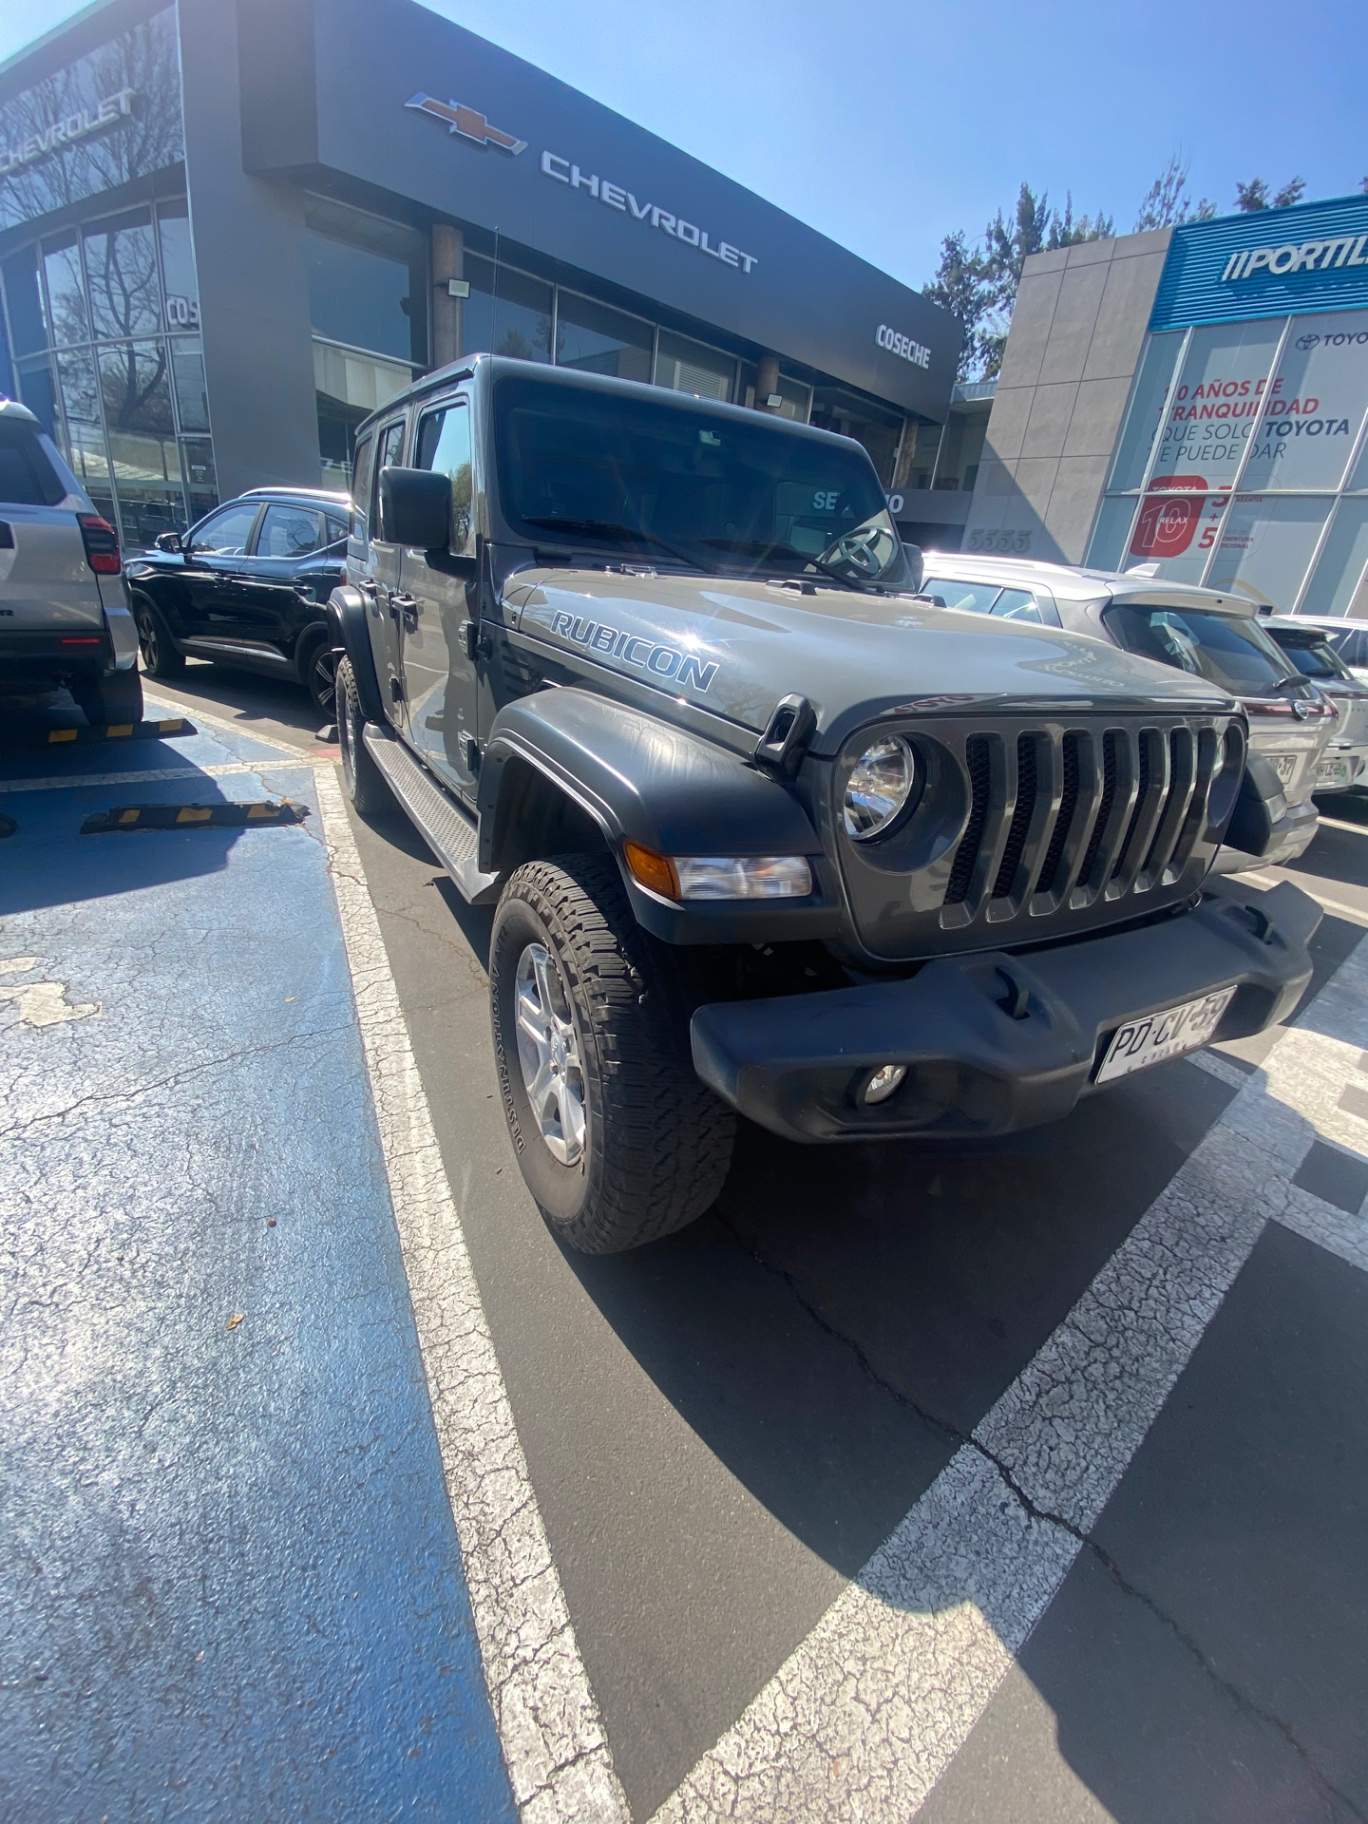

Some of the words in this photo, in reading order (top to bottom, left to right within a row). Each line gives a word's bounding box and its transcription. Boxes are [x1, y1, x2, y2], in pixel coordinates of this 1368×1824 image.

[541, 150, 758, 273] CHEVROLET
[876, 324, 931, 369] COSECHE
[1192, 379, 1250, 399] AÑOS
[1265, 419, 1349, 438] TOYOTA
[1176, 444, 1239, 461] PUEDE
[1198, 527, 1218, 548] 5
[550, 610, 720, 693] RUBICON
